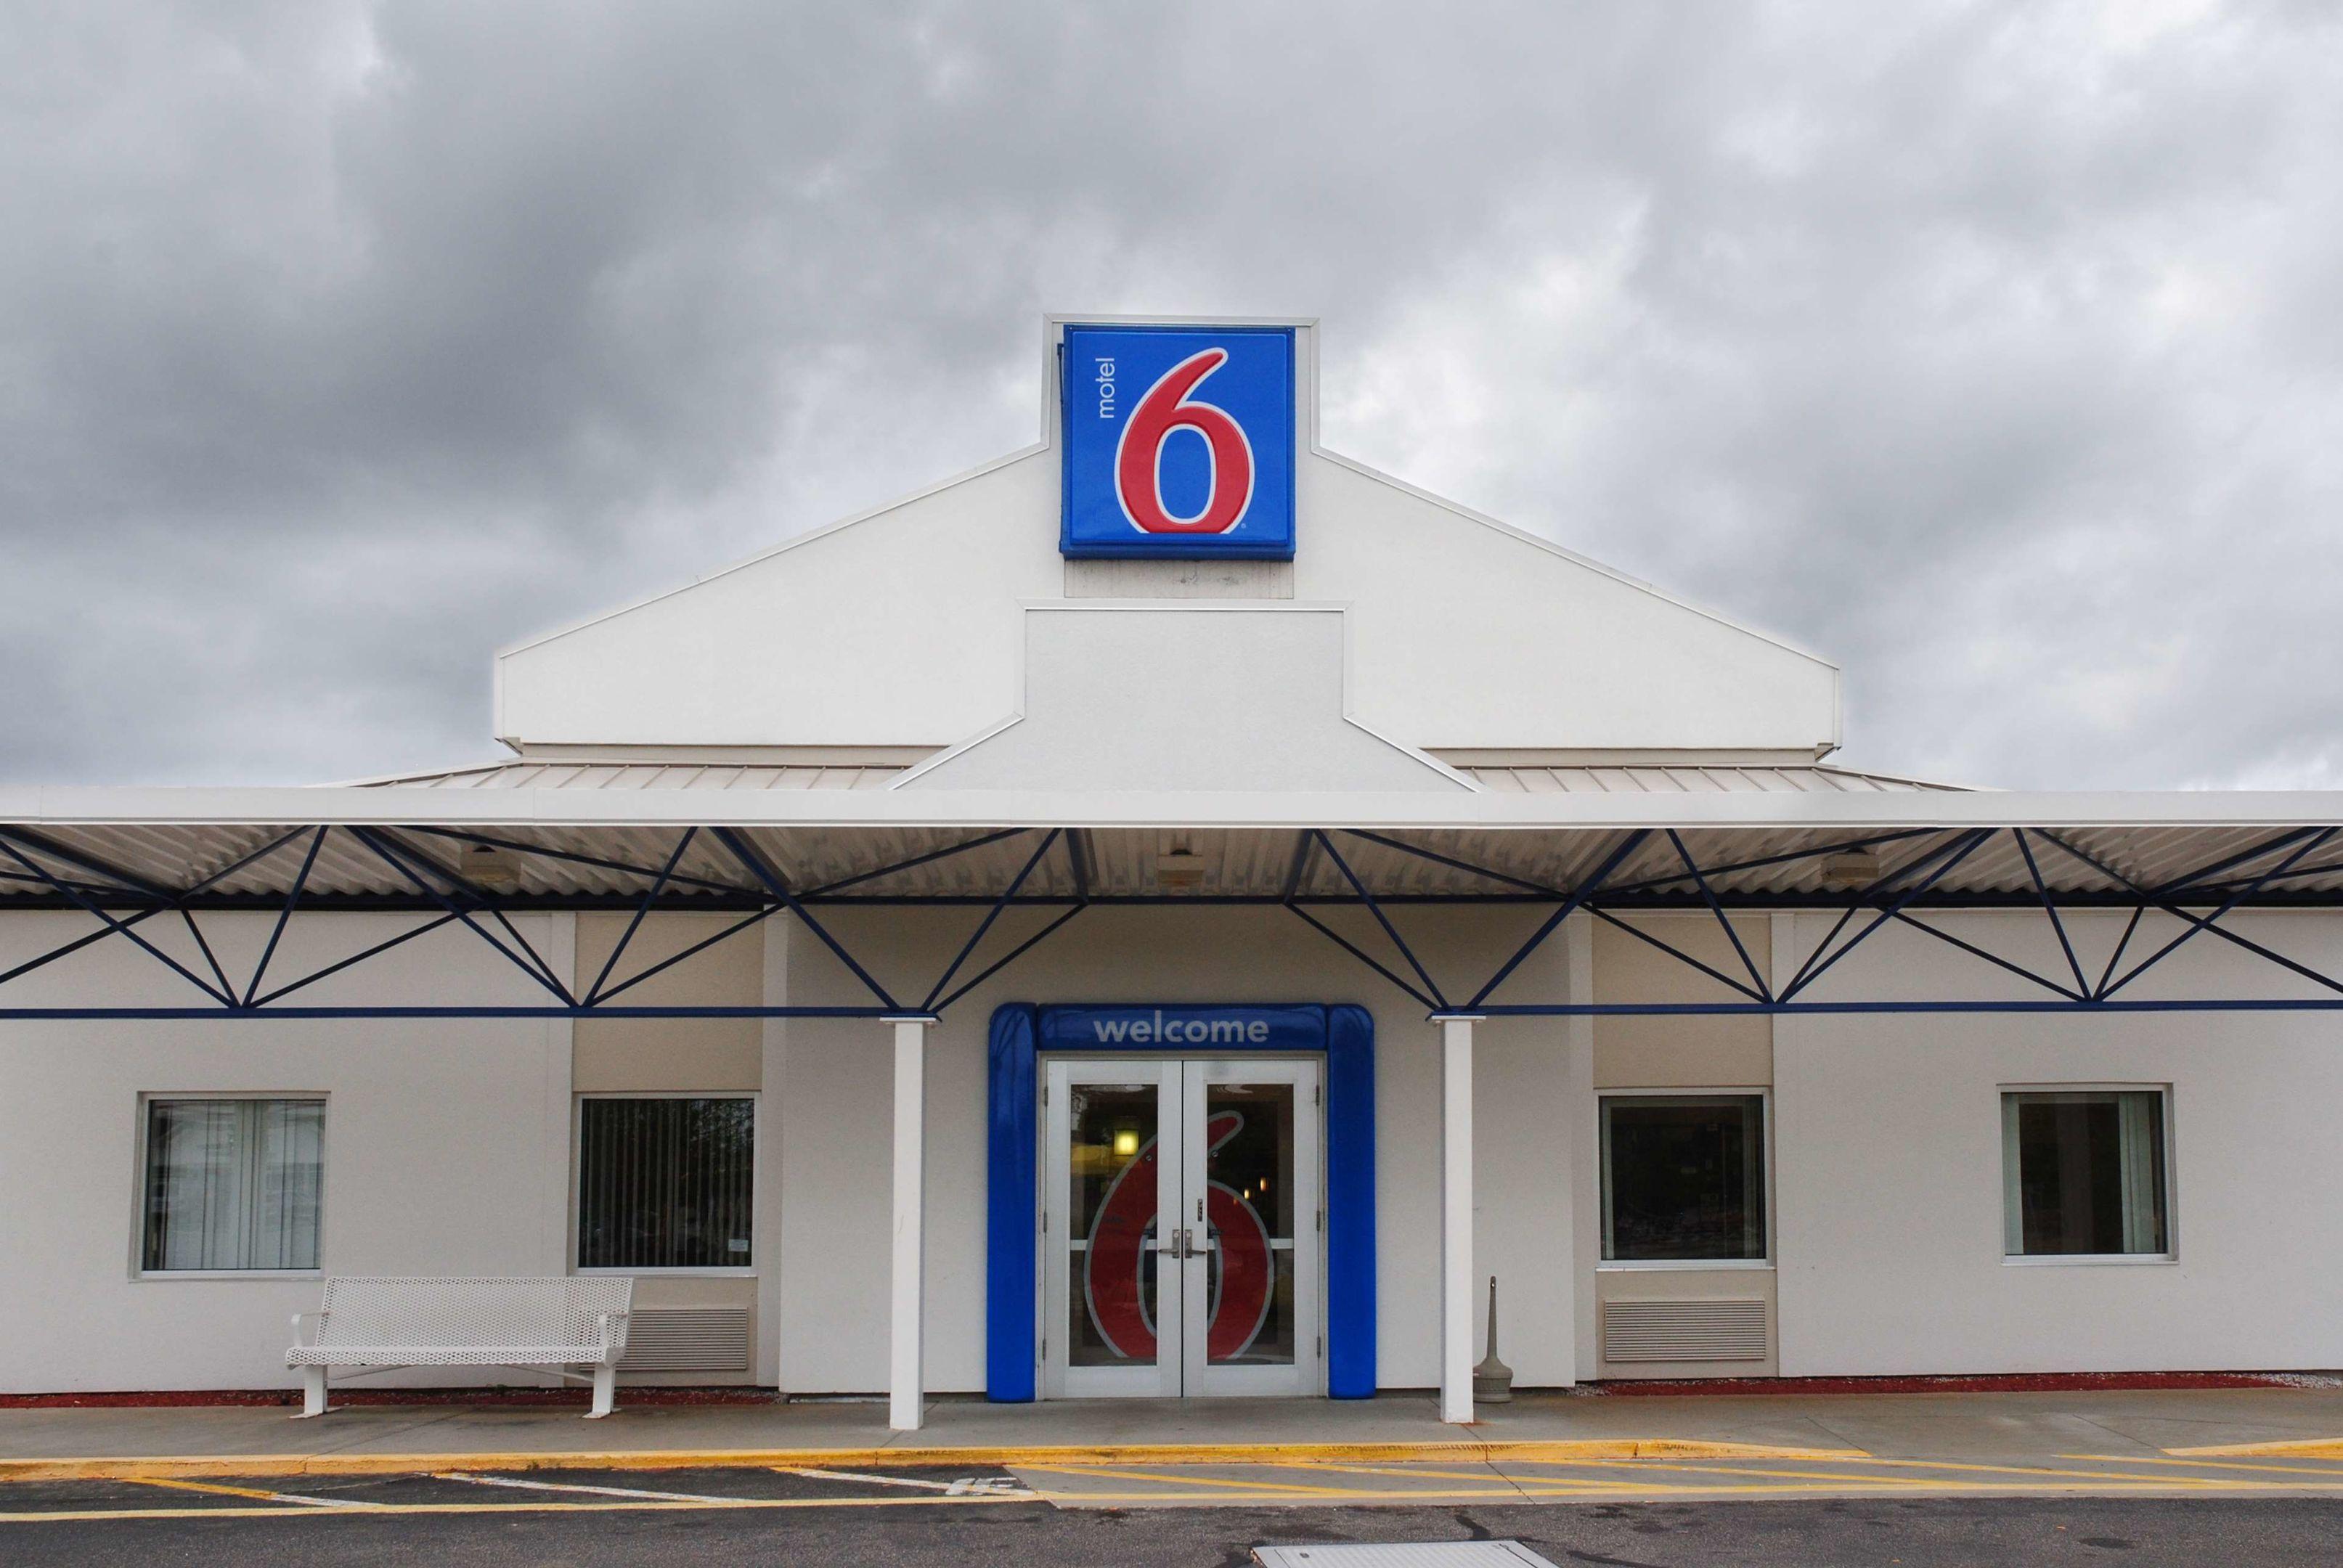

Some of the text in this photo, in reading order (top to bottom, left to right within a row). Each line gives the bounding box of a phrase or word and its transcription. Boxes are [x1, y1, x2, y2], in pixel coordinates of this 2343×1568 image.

[1096, 358, 1115, 419] motel
[1114, 347, 1255, 534] 6
[1093, 1010, 1269, 1042] welcome
[1084, 1111, 1274, 1360] 6
